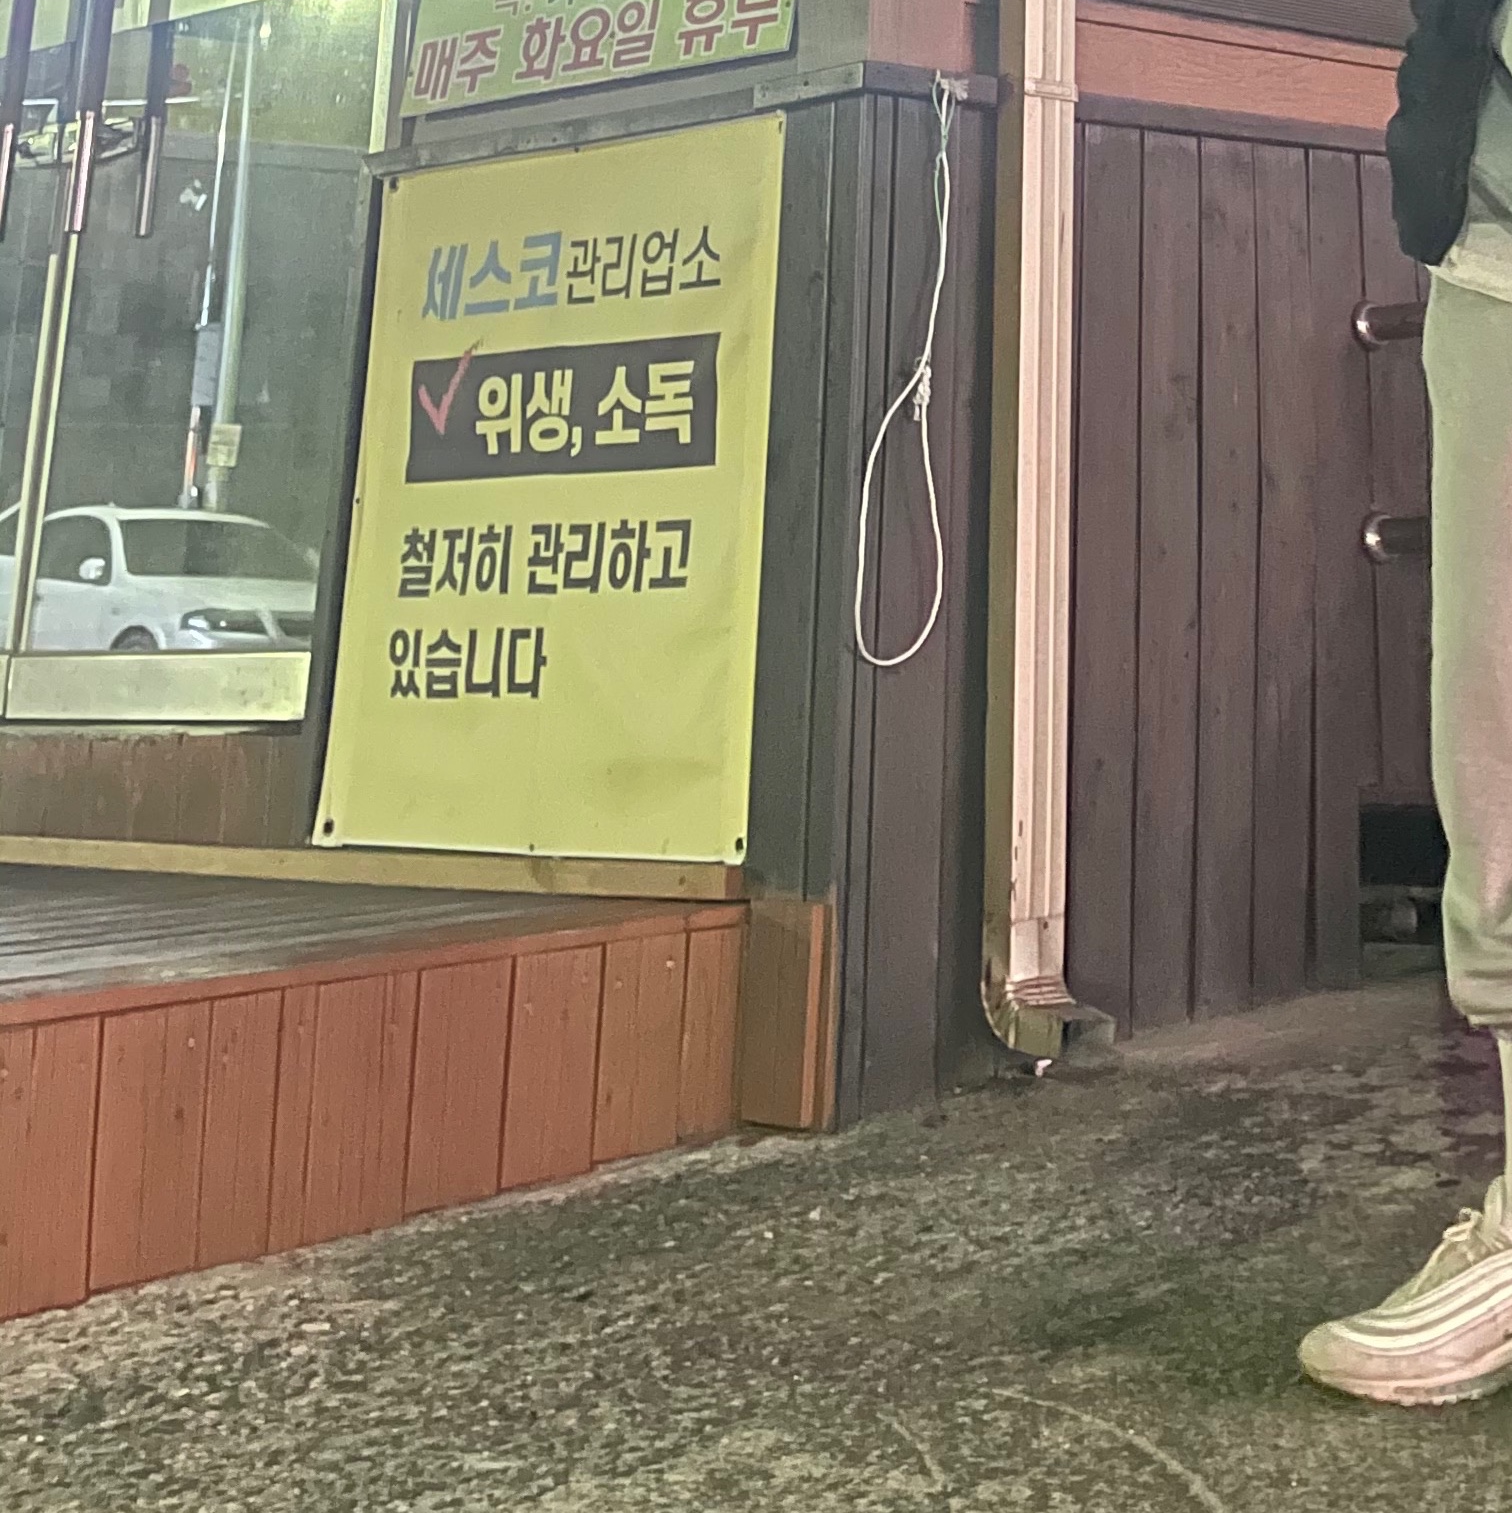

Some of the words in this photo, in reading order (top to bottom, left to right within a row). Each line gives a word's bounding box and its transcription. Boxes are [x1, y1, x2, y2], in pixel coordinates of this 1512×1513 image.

[412, 27, 501, 101] 매주
[475, 368, 583, 457] 위생,
[595, 360, 694, 445] 소독
[397, 525, 513, 598] 철저히
[527, 518, 692, 594] 관리하고
[389, 626, 547, 698] 있습니다
